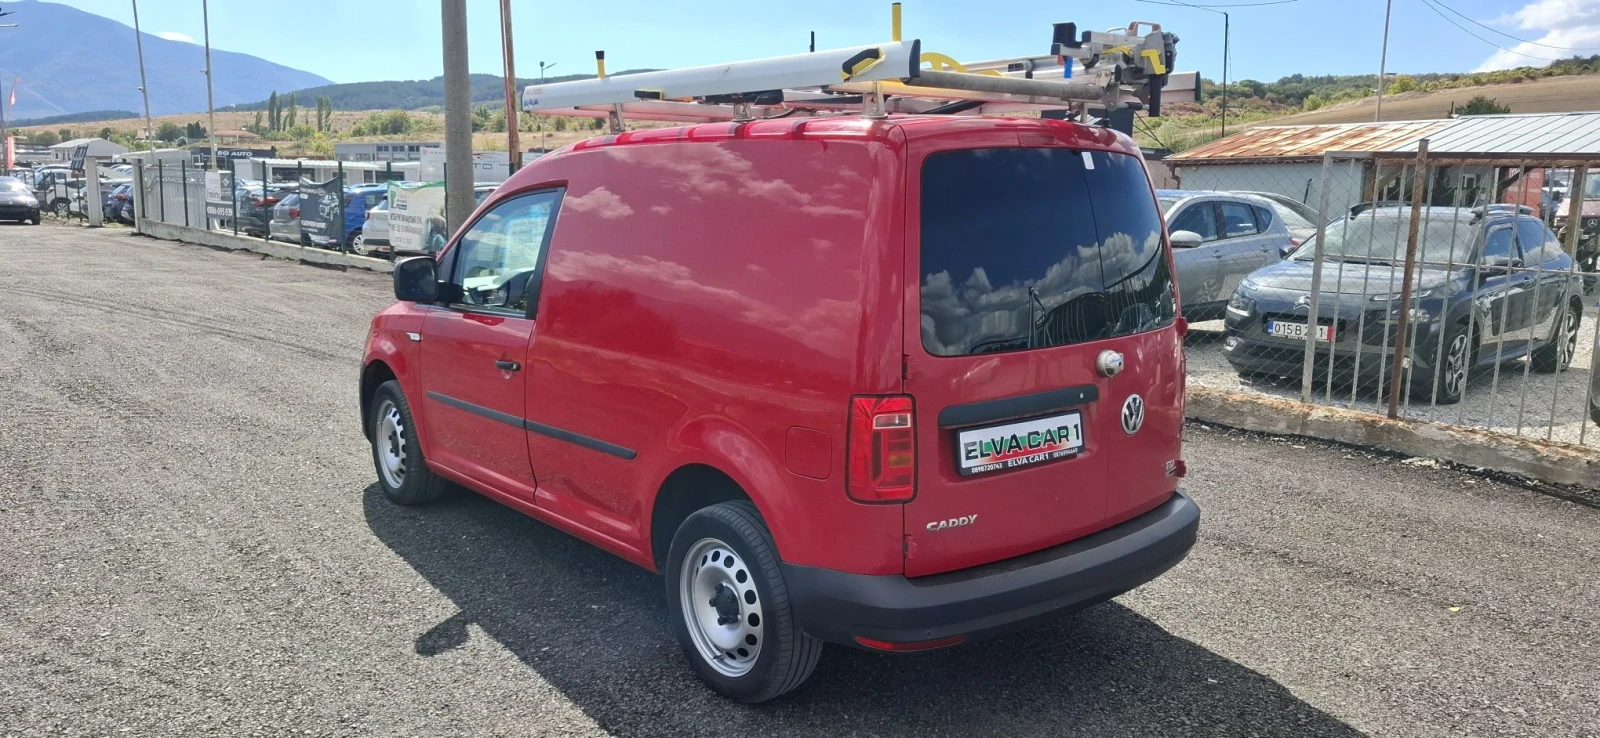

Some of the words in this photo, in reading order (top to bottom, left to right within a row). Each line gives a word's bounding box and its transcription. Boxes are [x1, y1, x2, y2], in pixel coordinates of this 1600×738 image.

[964, 433, 1023, 461] ELVA
[1027, 425, 1070, 450] CAR
[1073, 423, 1080, 440] 1
[1007, 457, 1028, 467] ELVA
[926, 513, 978, 532] CADDY
